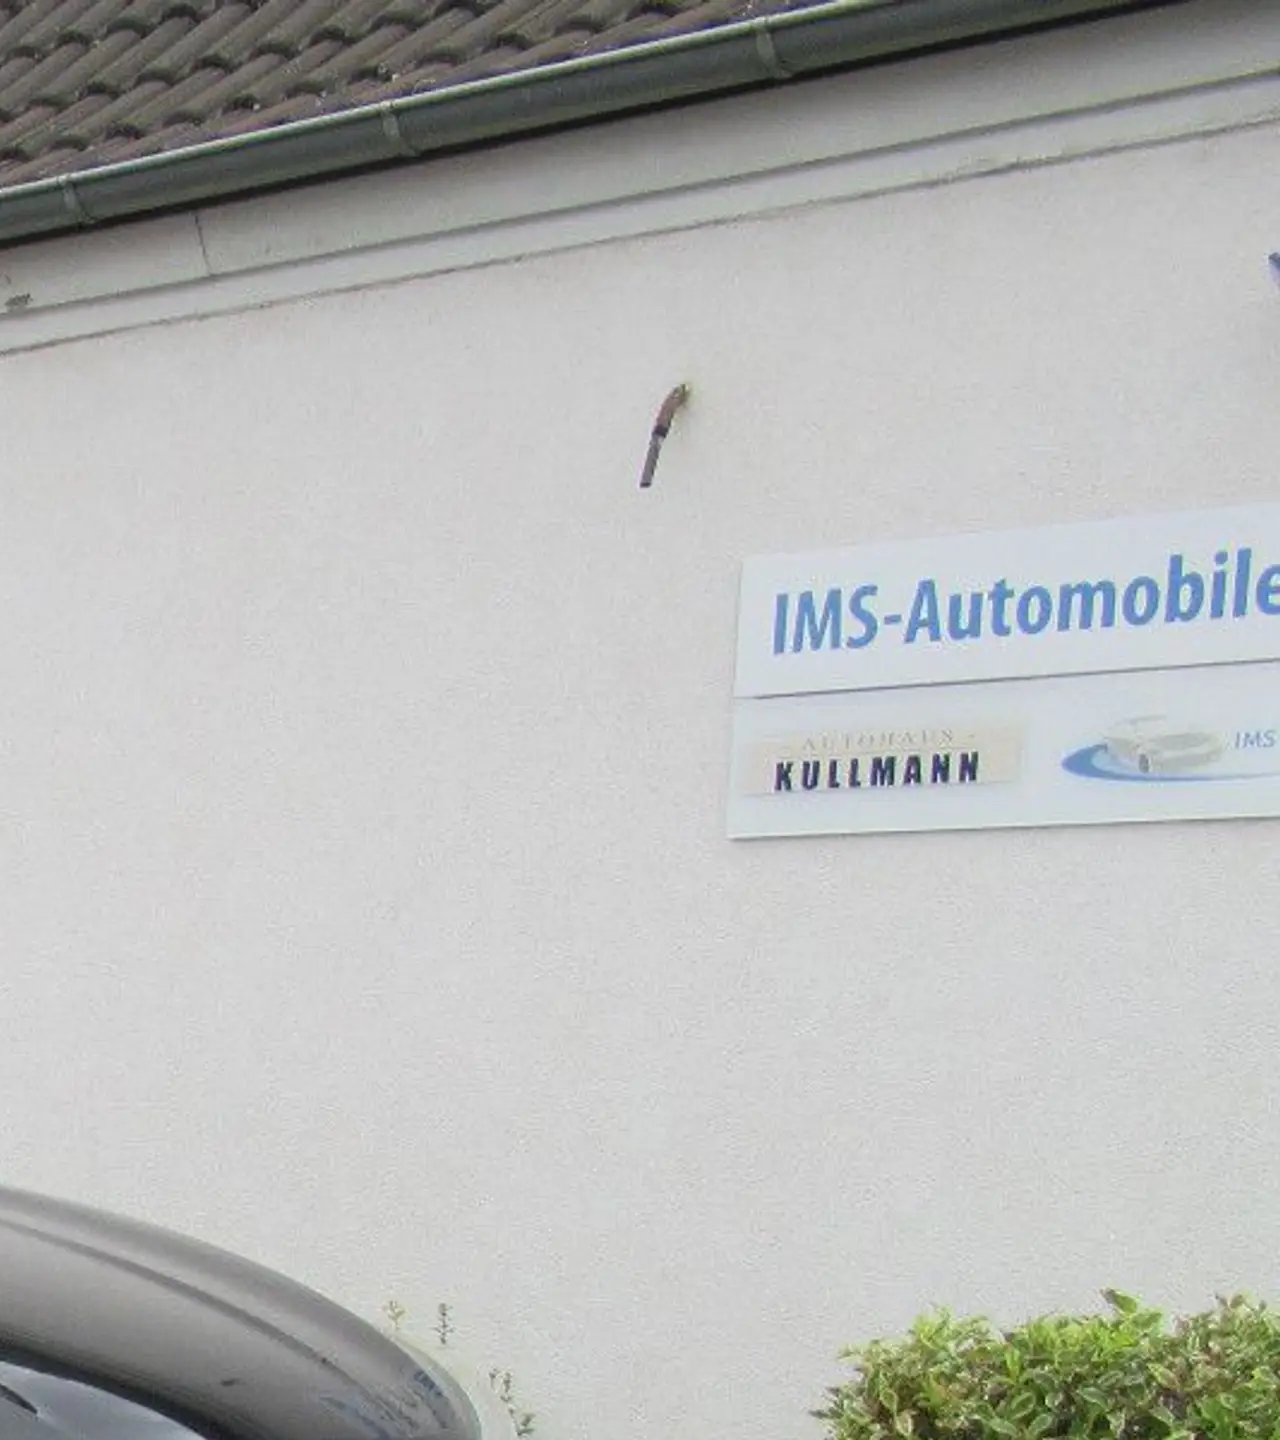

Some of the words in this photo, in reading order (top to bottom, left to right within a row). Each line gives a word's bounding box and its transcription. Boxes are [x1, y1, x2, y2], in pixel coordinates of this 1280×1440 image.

[773, 548, 1280, 655] IMS-Automobile
[1234, 729, 1277, 750] IMS
[774, 751, 979, 792] KULLMANN
